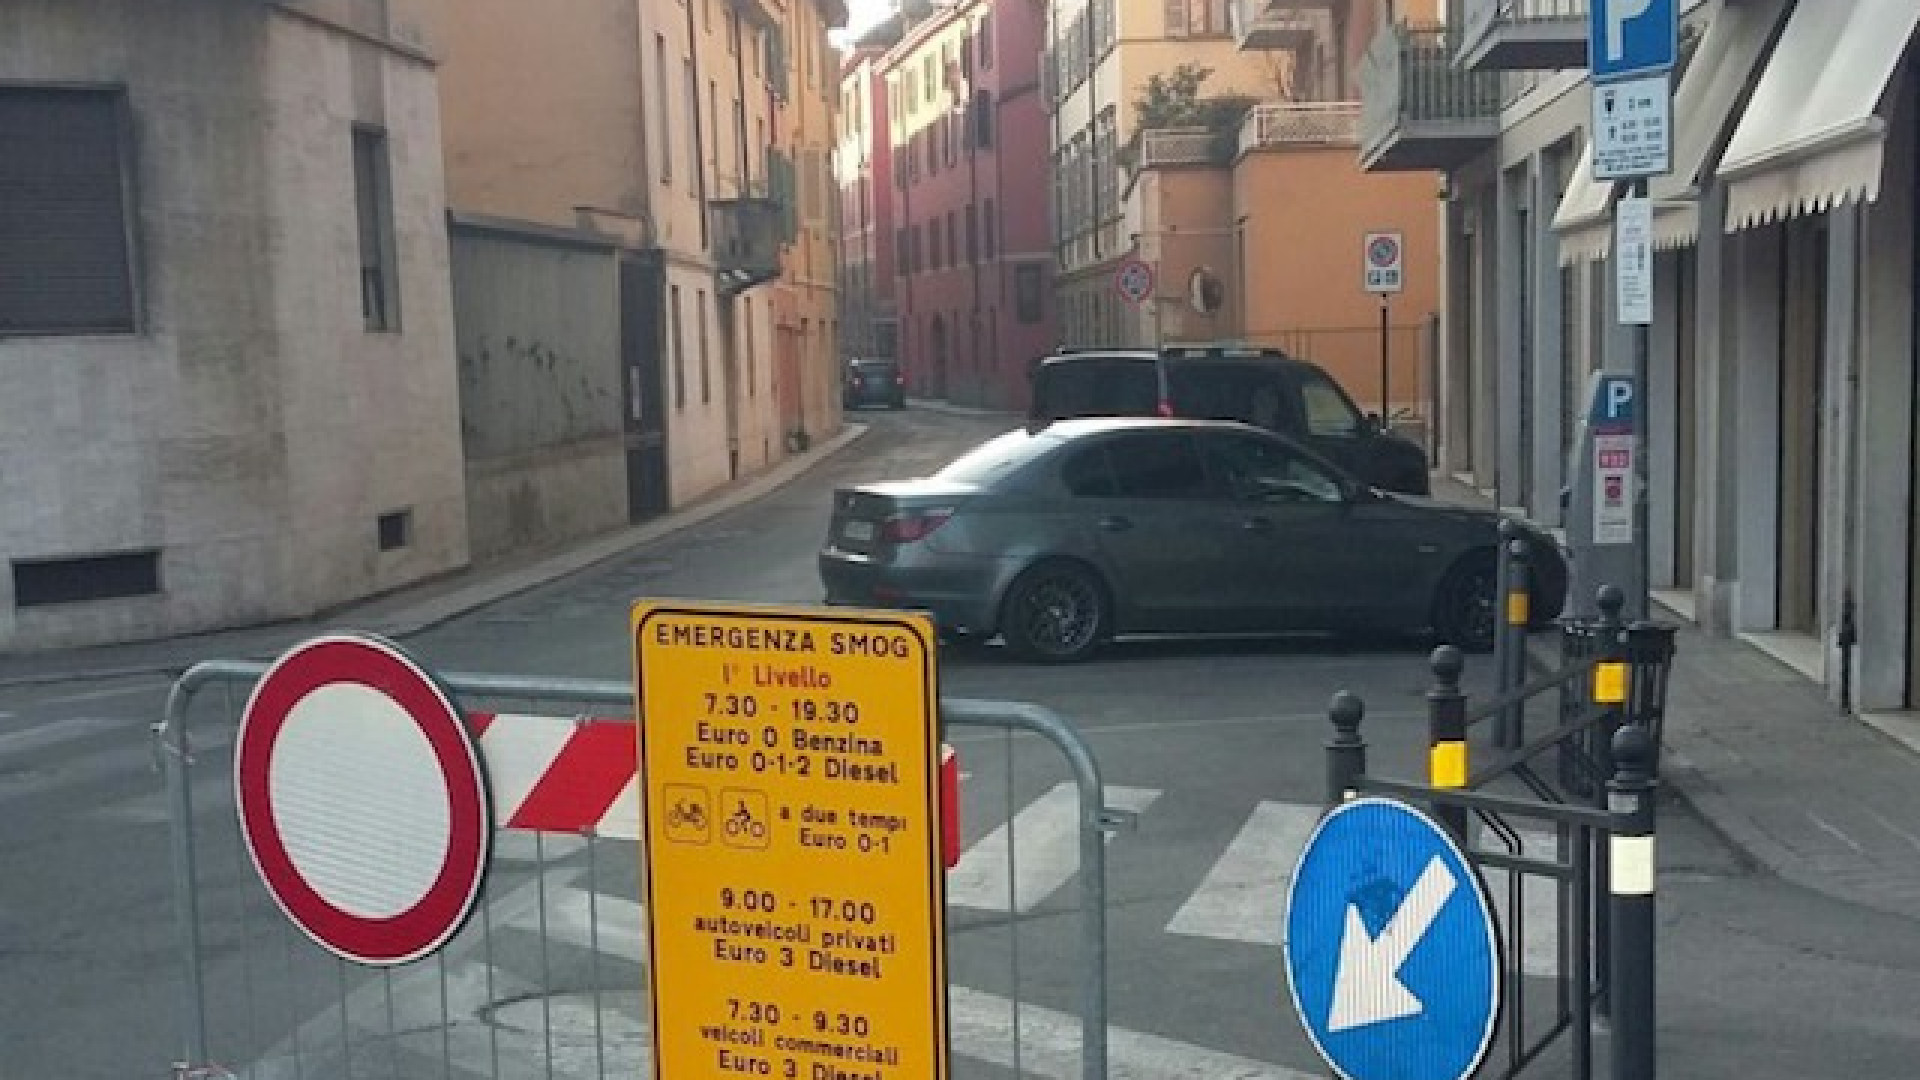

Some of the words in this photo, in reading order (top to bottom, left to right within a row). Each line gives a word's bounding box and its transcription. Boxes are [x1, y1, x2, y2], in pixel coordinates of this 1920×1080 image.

[1607, 380, 1633, 417] P
[656, 624, 815, 651] EMERGENZA
[831, 632, 909, 658] SMOG
[753, 663, 831, 688] Livello
[704, 693, 757, 718] 7.30
[791, 699, 859, 724] 19.30
[697, 721, 750, 745] Euro
[762, 725, 778, 748] 0
[791, 728, 883, 756] Benzina
[686, 746, 738, 771] Euro
[752, 751, 811, 777] 0-1-2
[824, 757, 899, 784] Diesel
[801, 804, 838, 825] due
[848, 809, 907, 833] tempi
[800, 828, 847, 850] Euro
[858, 833, 889, 855] 0-1
[721, 887, 775, 913] 9.00
[810, 896, 876, 925] 17.00
[694, 915, 811, 943] autoveicoli
[821, 929, 896, 954] privati
[714, 939, 768, 964] Euro
[780, 947, 794, 968] 3
[808, 950, 883, 979] Diesel
[727, 998, 780, 1026] 7.30
[812, 1010, 869, 1038] 9.30
[700, 1025, 765, 1048] veicoli
[774, 1036, 899, 1065] commerciali
[718, 1049, 772, 1075] Euro
[783, 1058, 797, 1078] 3
